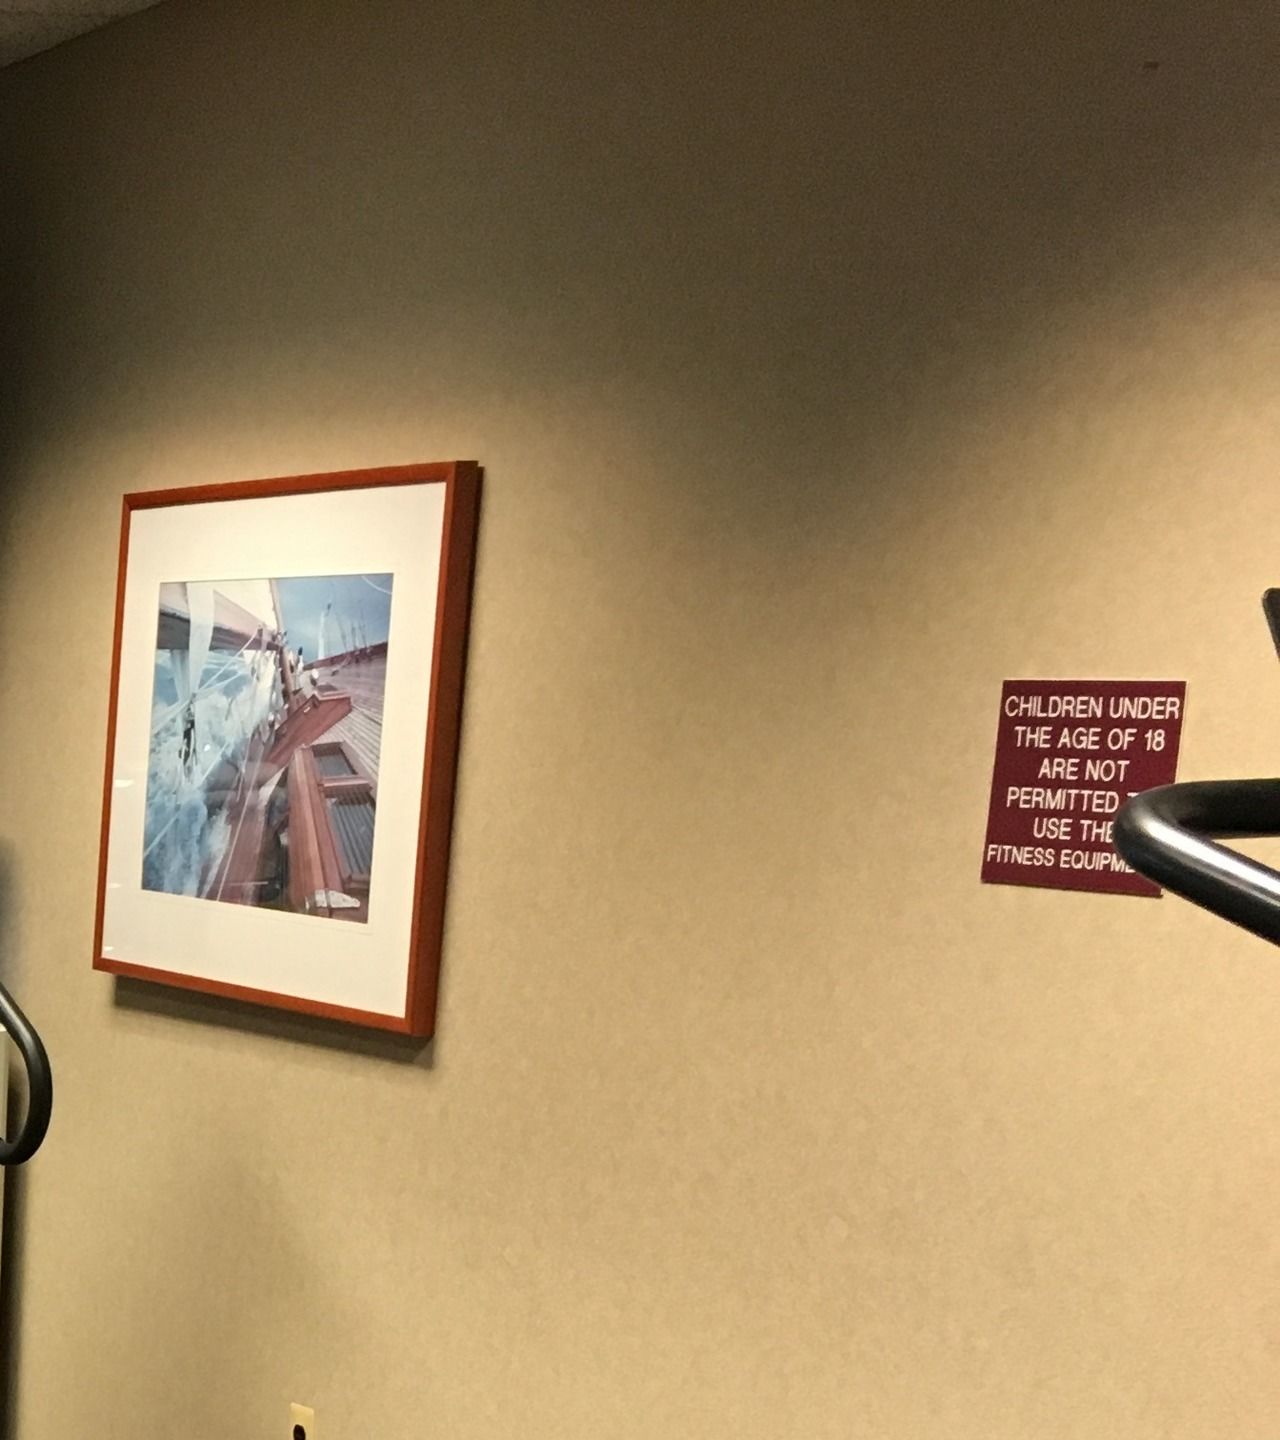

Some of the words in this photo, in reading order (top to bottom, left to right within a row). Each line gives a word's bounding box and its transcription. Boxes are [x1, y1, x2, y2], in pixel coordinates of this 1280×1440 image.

[1005, 696, 1102, 718] CHILDREN
[1109, 697, 1180, 719] UNDER
[1015, 726, 1051, 748] THE
[1057, 727, 1101, 750] AGE
[1108, 728, 1137, 750] OF
[1144, 729, 1166, 751] 18
[1038, 758, 1080, 781] ARE
[1085, 759, 1130, 782] NOT
[1007, 787, 1119, 813] PERMITTED
[1033, 818, 1072, 840] USE
[1080, 820, 1113, 843] THE
[987, 845, 1055, 866] FITNESS
